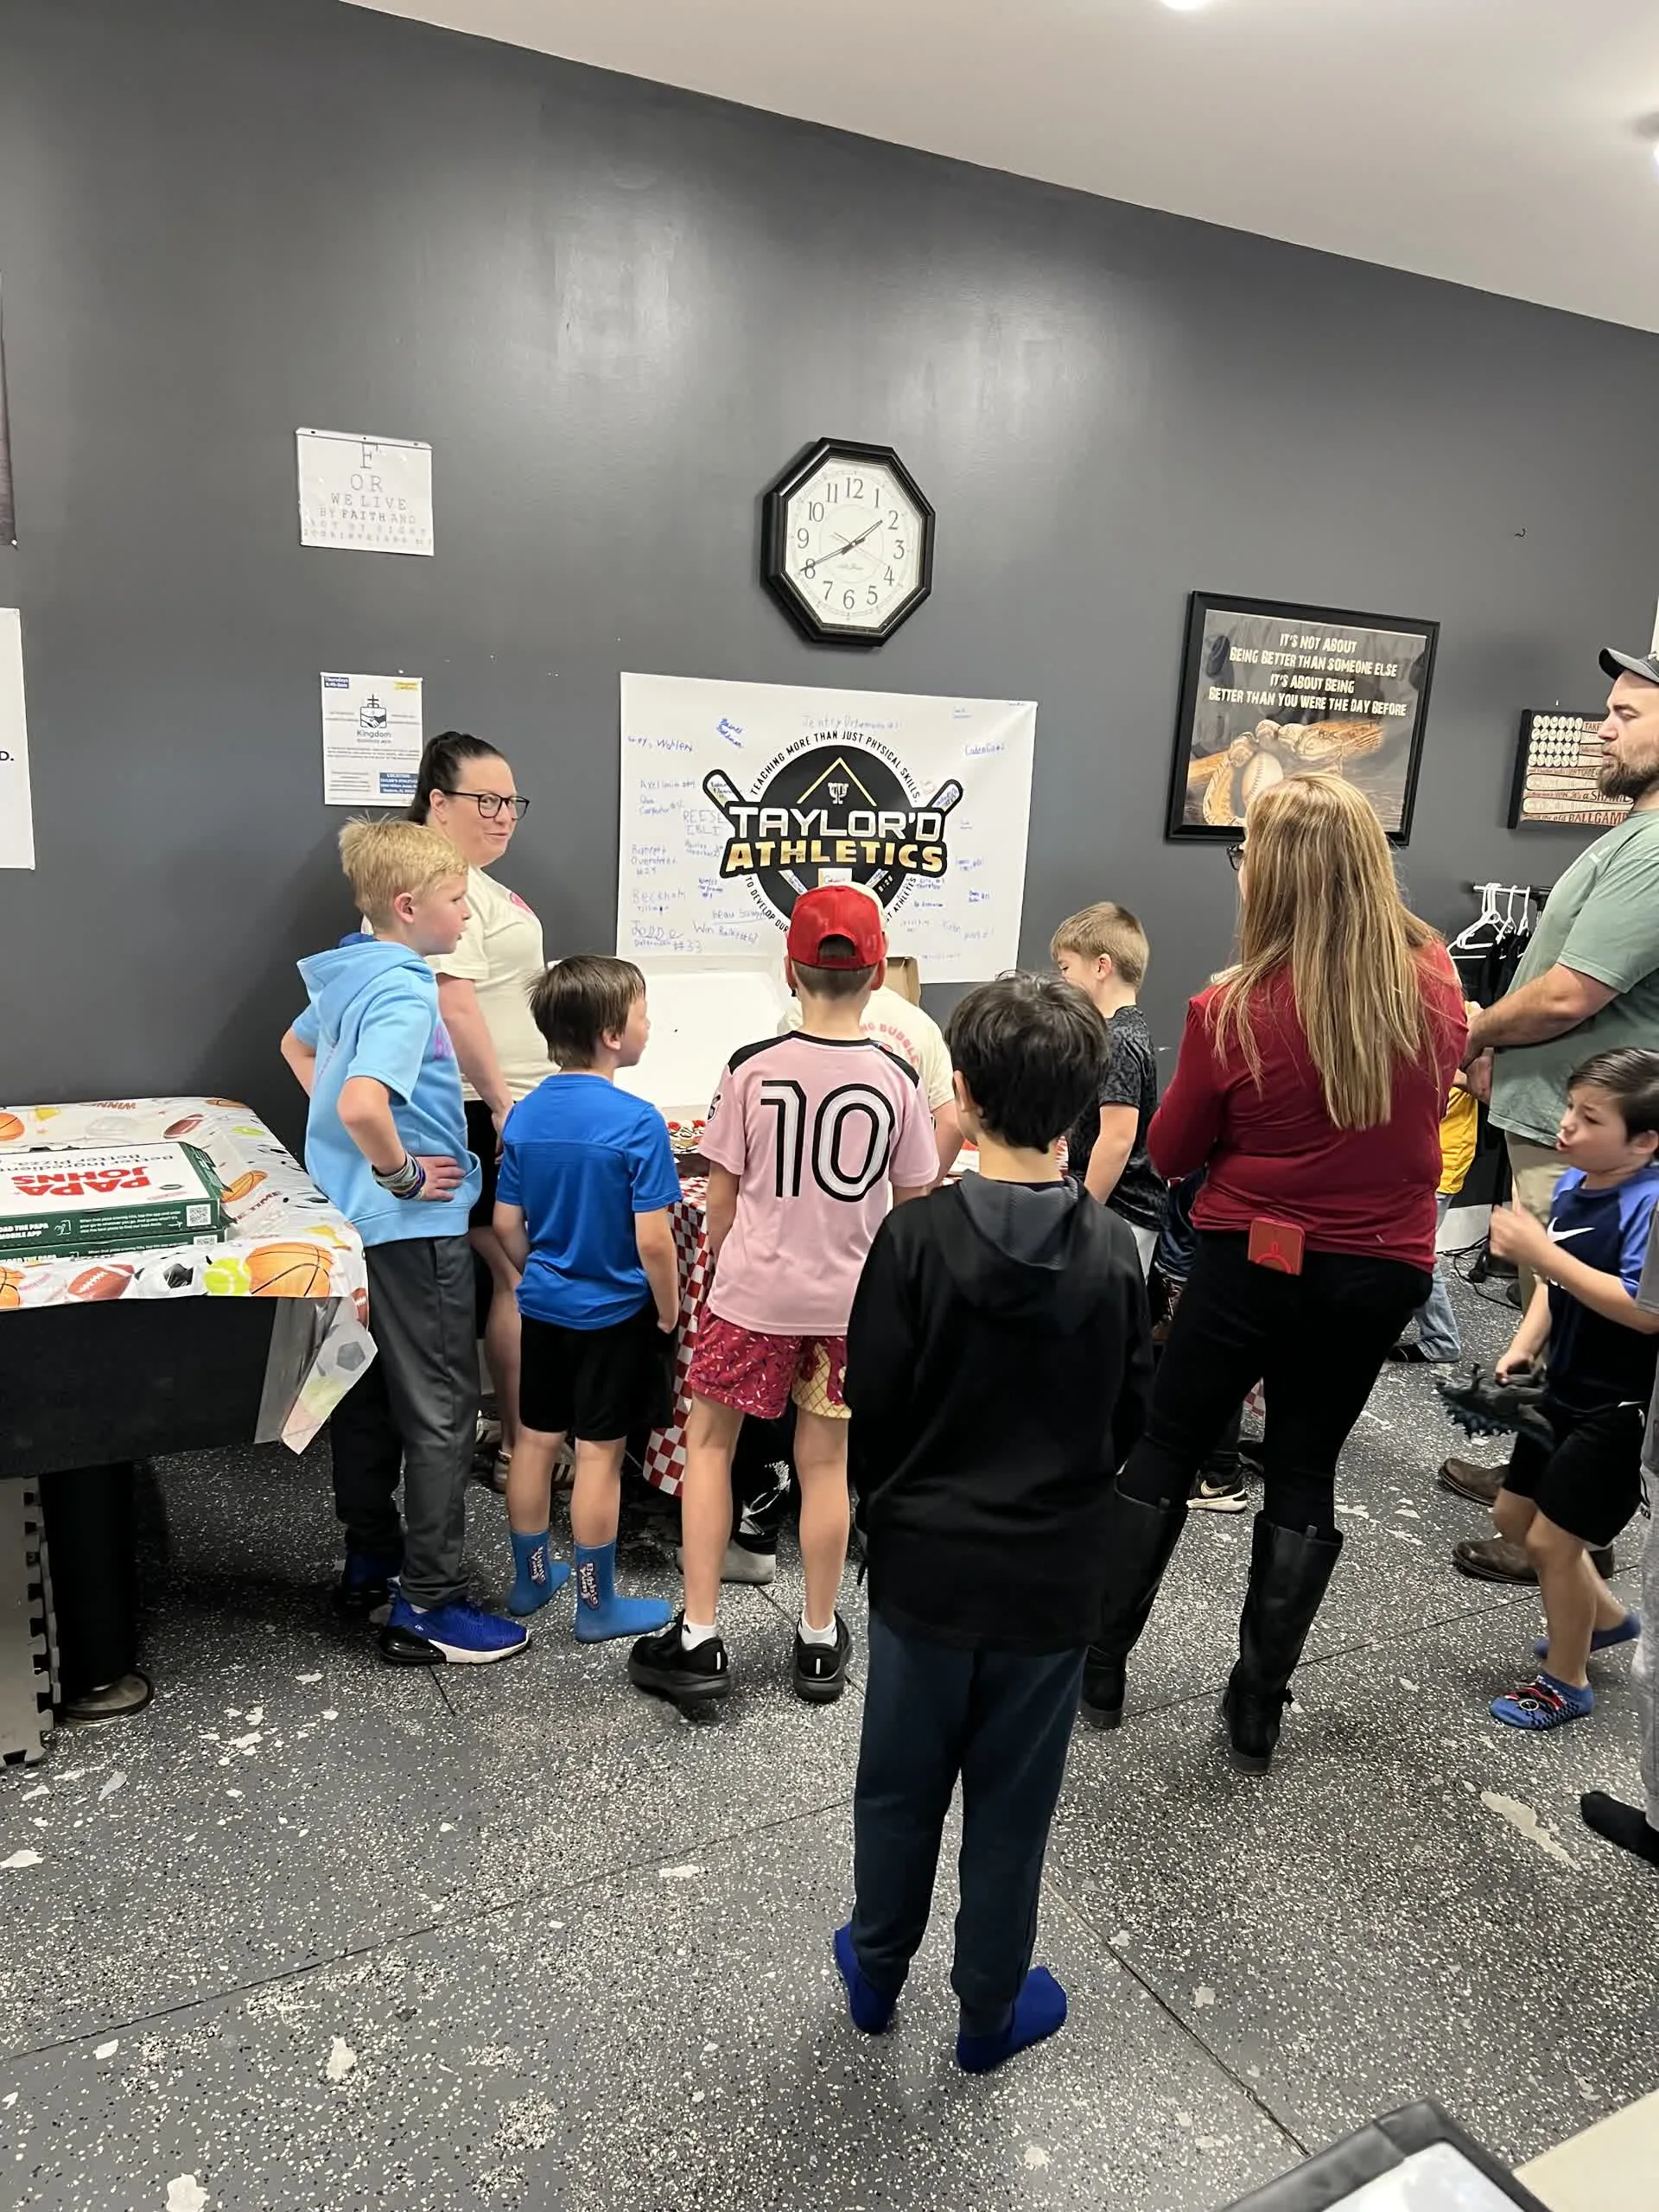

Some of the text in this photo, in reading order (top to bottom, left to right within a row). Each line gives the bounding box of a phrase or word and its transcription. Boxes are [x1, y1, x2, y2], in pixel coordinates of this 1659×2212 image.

[350, 473, 384, 493] OR
[826, 482, 838, 504] 11
[846, 476, 864, 499] 12
[331, 492, 408, 512] WE LIVE
[874, 487, 880, 509] 1
[341, 508, 386, 523] FAITH
[390, 512, 416, 524] AND
[808, 501, 825, 523] 10
[887, 510, 899, 531] 2
[797, 527, 810, 550] 9
[893, 539, 906, 560] 3
[804, 557, 817, 580] 8
[883, 565, 895, 587] 4
[822, 580, 834, 601] 7
[842, 588, 855, 610] 6
[866, 585, 879, 606] 5
[1279, 633, 1357, 654] IT'S NOT ABOUT
[1230, 646, 1398, 677] BEING BETTER THAN SOMEONE ELSE
[1269, 673, 1355, 694] IT'S ABOUT BEING
[1208, 686, 1408, 717] BETTER THAN YOU WERE THE DAY BEFORE
[750, 753, 786, 797] TEACHING
[785, 735, 811, 756] MORE
[813, 730, 839, 743] THAN
[841, 731, 864, 743] JUST
[865, 735, 902, 770] PHYSICAL
[683, 809, 728, 824] REESE
[728, 806, 943, 842] TAYLOR'D
[724, 840, 945, 874] ATHLETICS
[750, 888, 776, 920] DEVELOP
[760, 1080, 895, 1202] 10
[79, 1154, 140, 1163] Better
[111, 1155, 174, 1166] Better
[11, 1166, 150, 1185] JOHNS
[16, 1176, 151, 1197] PAPA
[586, 1562, 599, 1605] Bubble
